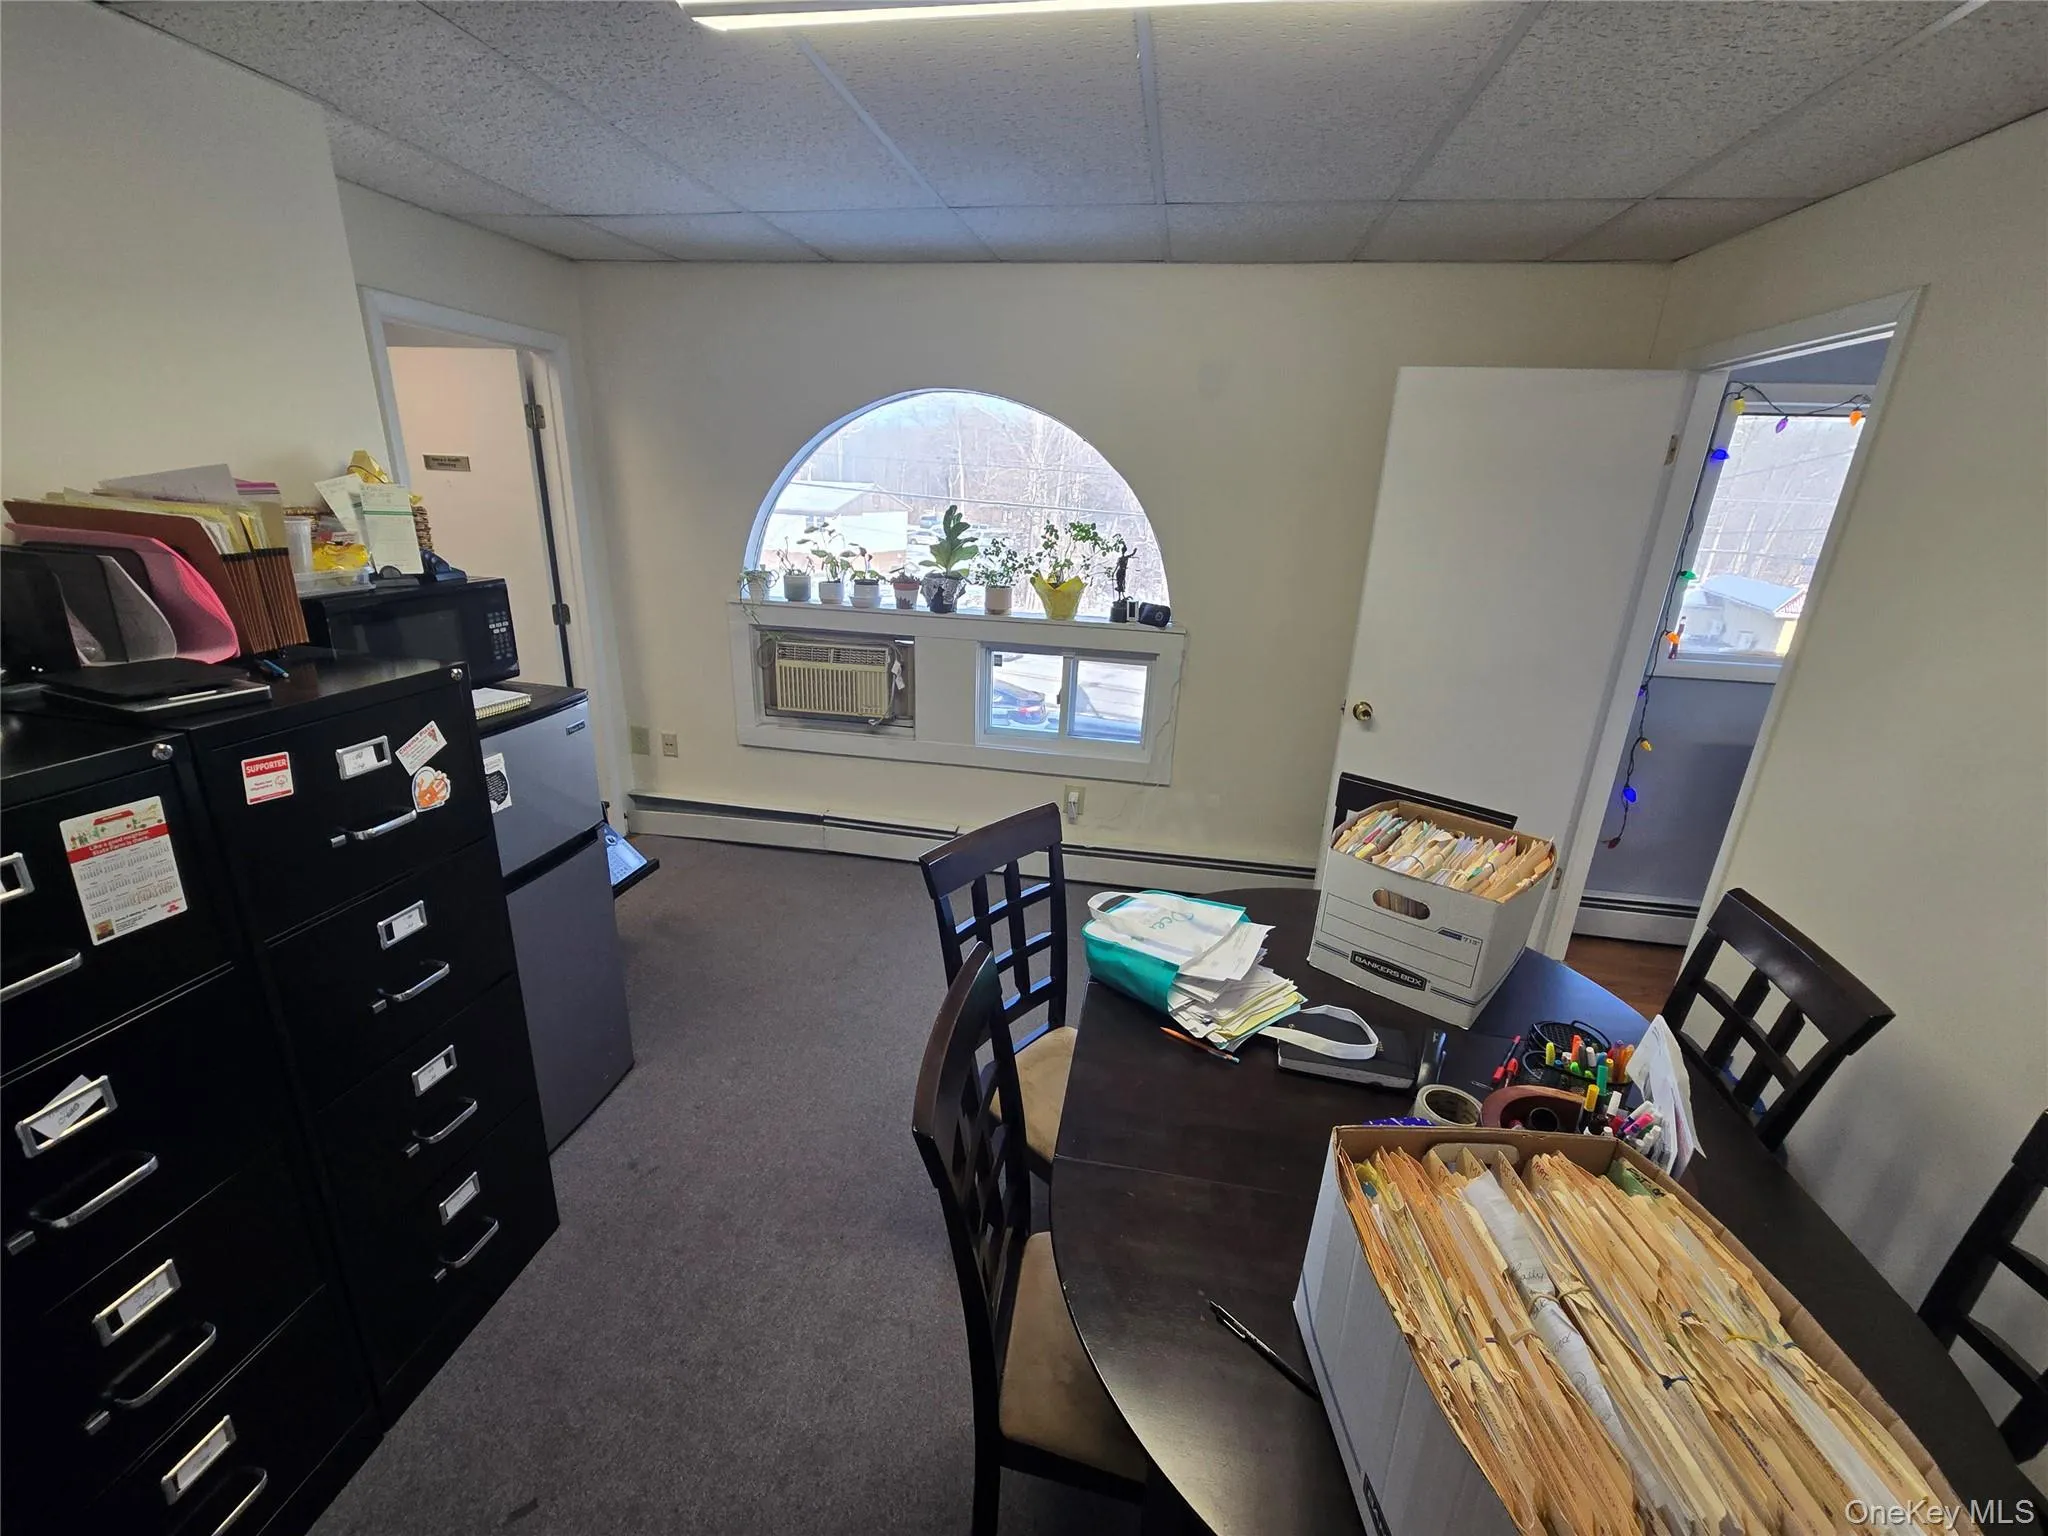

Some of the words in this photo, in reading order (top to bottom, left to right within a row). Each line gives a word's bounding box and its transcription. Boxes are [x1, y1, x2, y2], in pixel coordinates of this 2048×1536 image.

[246, 759, 287, 774] SUPPORTER
[1355, 955, 1400, 978] BANKERS
[1399, 972, 1422, 986] BOX
